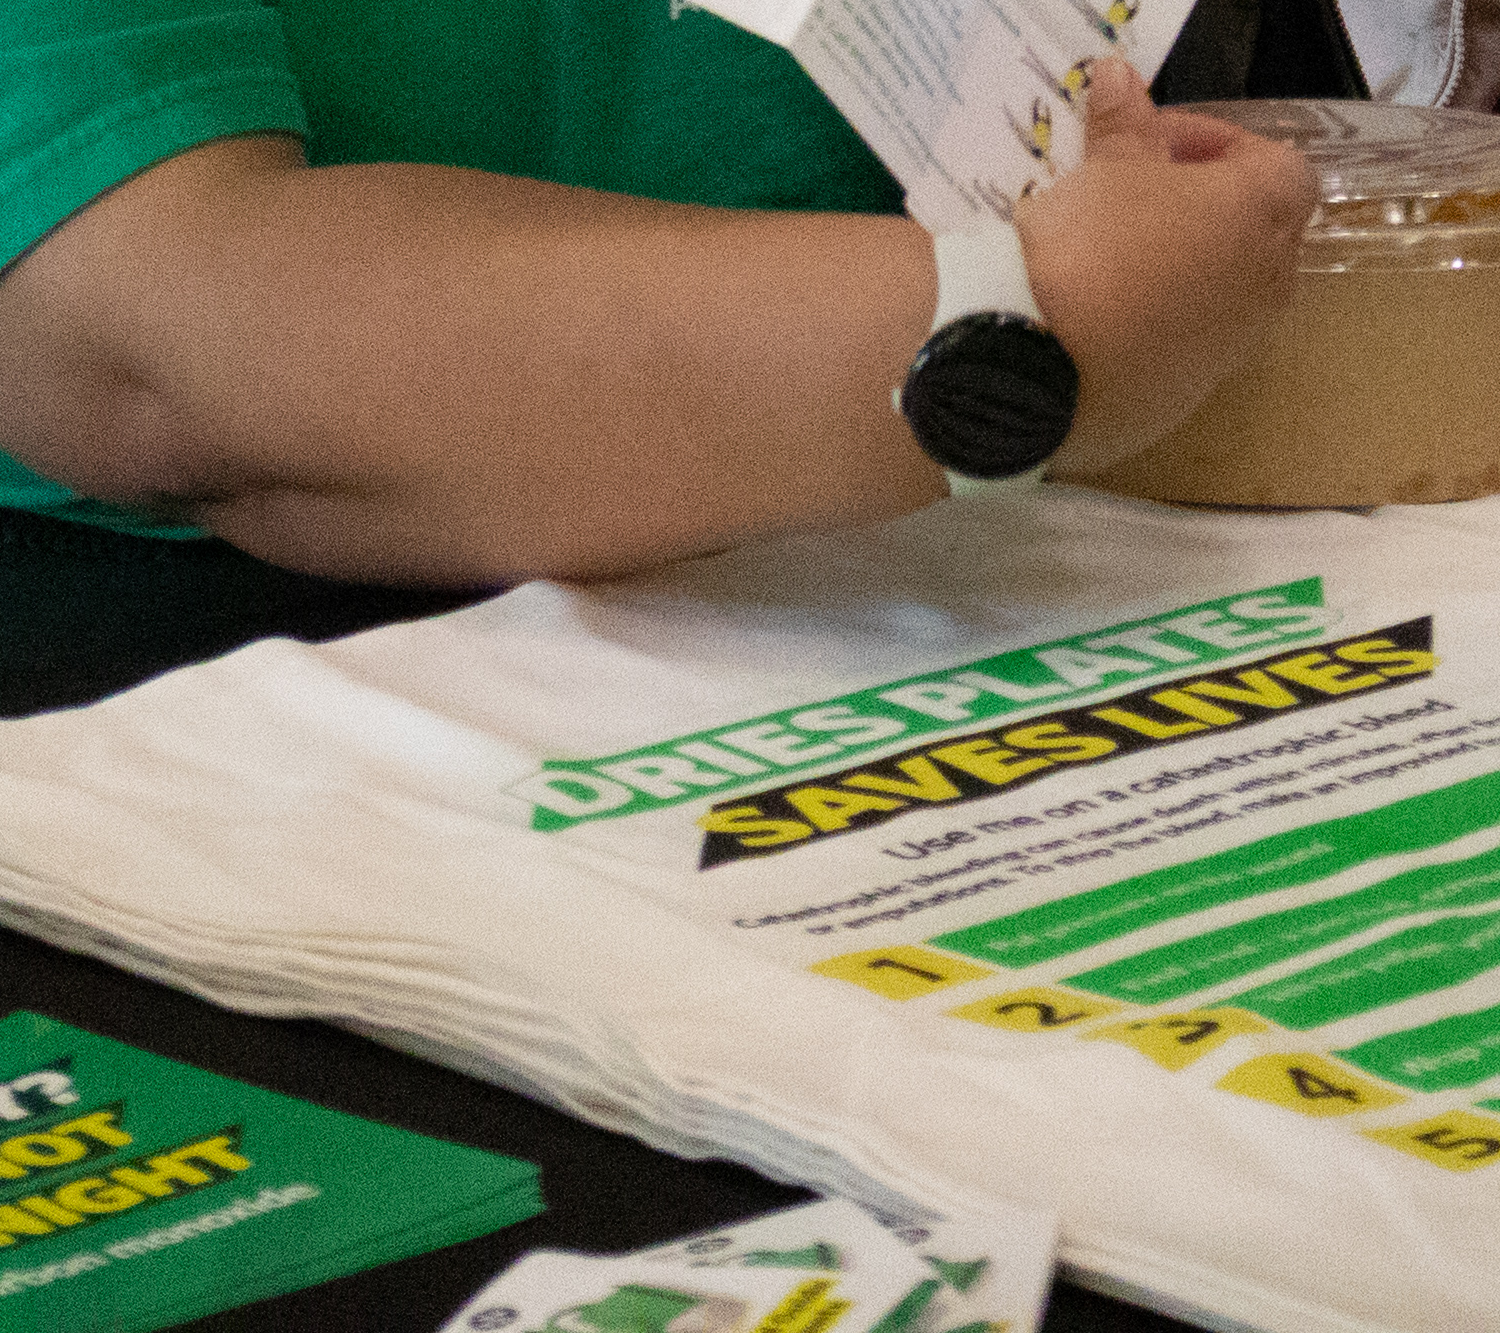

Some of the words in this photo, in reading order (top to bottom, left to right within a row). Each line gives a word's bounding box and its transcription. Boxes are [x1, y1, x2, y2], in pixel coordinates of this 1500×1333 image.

[502, 691, 886, 817] DRIES
[888, 589, 1352, 726] PLATES
[699, 721, 1102, 850] SAVES
[1103, 636, 1444, 742] LIVES
[881, 830, 978, 861] Use
[976, 812, 1042, 835] me
[1043, 796, 1099, 820] on
[1099, 787, 1126, 803] a
[1129, 728, 1344, 795] catastrophic
[908, 851, 1029, 888] bleeding
[1029, 837, 1071, 855] can
[866, 957, 949, 985] 1
[996, 999, 1090, 1030] 2
[1150, 1013, 1227, 1048] 3
[1286, 1062, 1361, 1104] 4
[106, 1183, 322, 1261] monoxide
